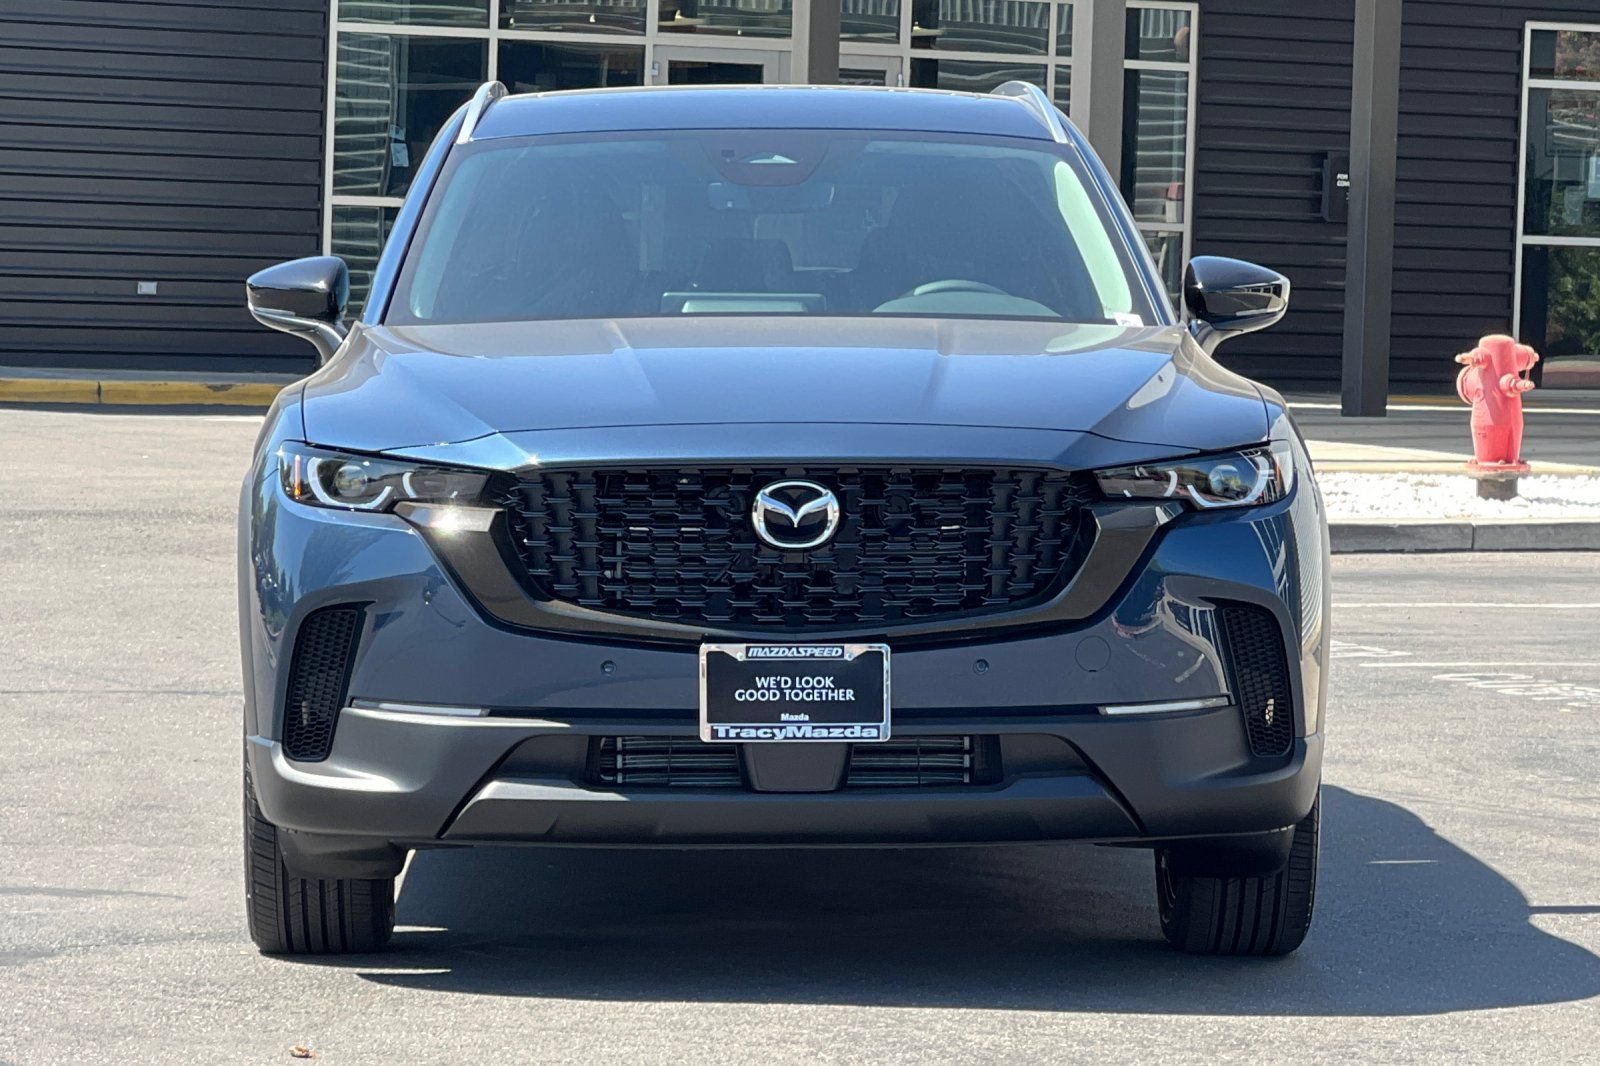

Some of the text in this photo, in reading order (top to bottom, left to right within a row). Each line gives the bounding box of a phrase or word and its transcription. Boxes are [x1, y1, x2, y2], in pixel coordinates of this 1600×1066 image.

[748, 647, 842, 657] MAZDASPEED
[756, 676, 835, 688] WE'D LOOK
[735, 689, 855, 701] GOOD TOGETHER
[780, 713, 809, 721] Mazda
